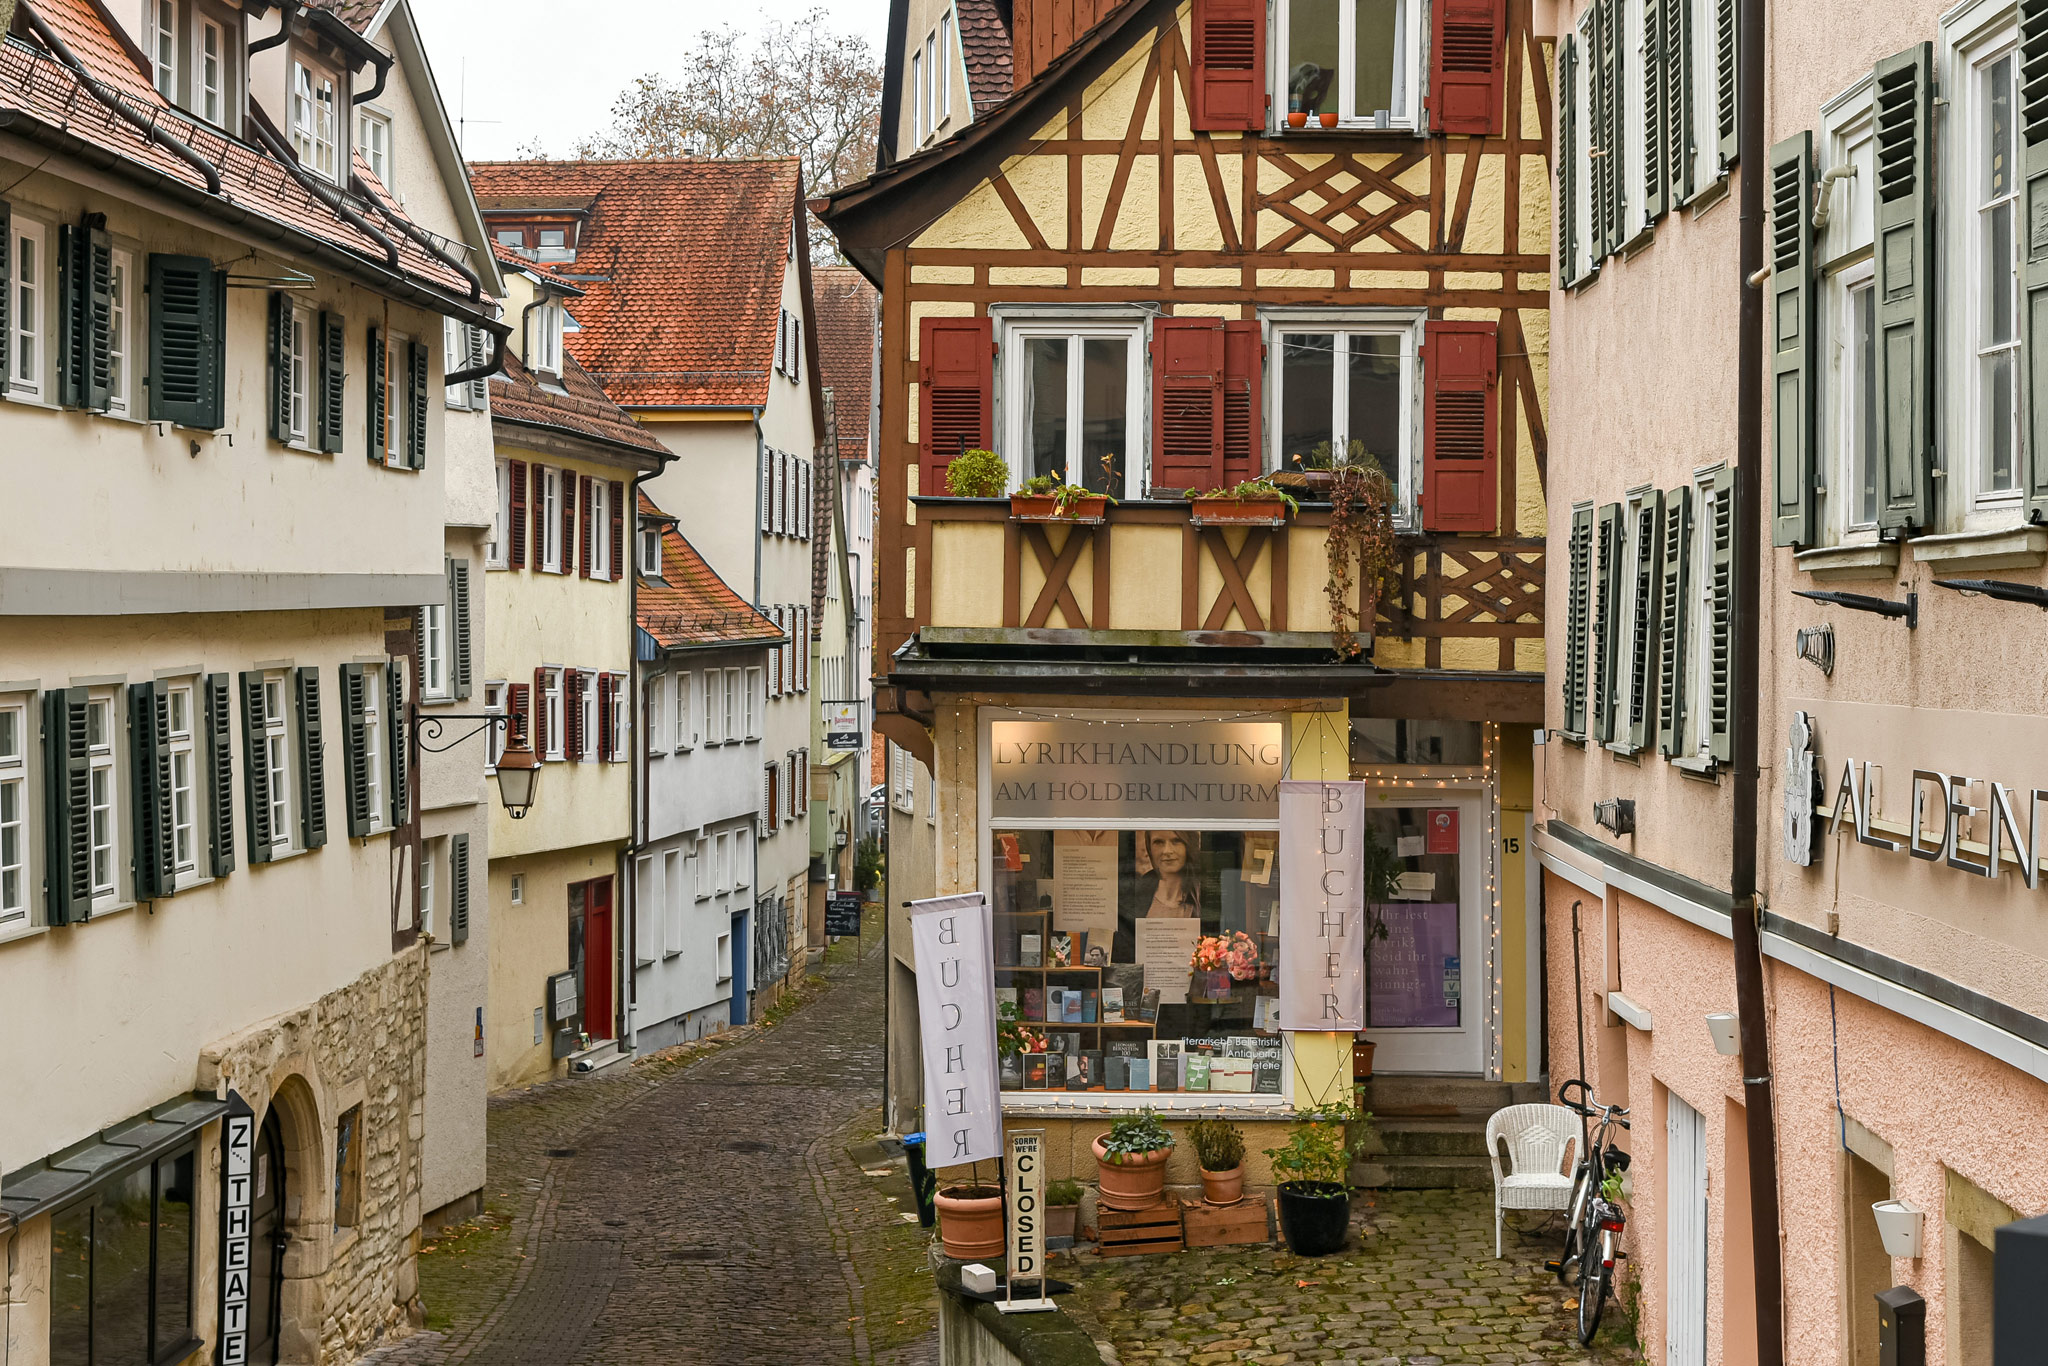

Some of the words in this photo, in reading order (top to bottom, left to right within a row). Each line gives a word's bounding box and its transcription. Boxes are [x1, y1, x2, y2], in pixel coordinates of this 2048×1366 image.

[995, 742, 1280, 766] LYRIKHANDLUNG
[995, 781, 1038, 802] AM
[1047, 779, 1280, 803] HÖLDERLINTURM
[1828, 757, 1900, 852] AL
[1910, 769, 2048, 890] DEN
[1502, 837, 1520, 854] 15
[1316, 786, 1346, 1020] BÜCHER
[1375, 908, 1400, 920] Ihr
[1405, 908, 1430, 920] lest
[1374, 936, 1416, 950] Lyrik?
[1374, 950, 1402, 962] Seid
[1407, 950, 1427, 962] ihr
[1374, 964, 1416, 976] wahn-
[1014, 1137, 1038, 1146] SORRY
[1015, 1145, 1038, 1153] WE'RE
[1017, 1155, 1035, 1273] CLOSED
